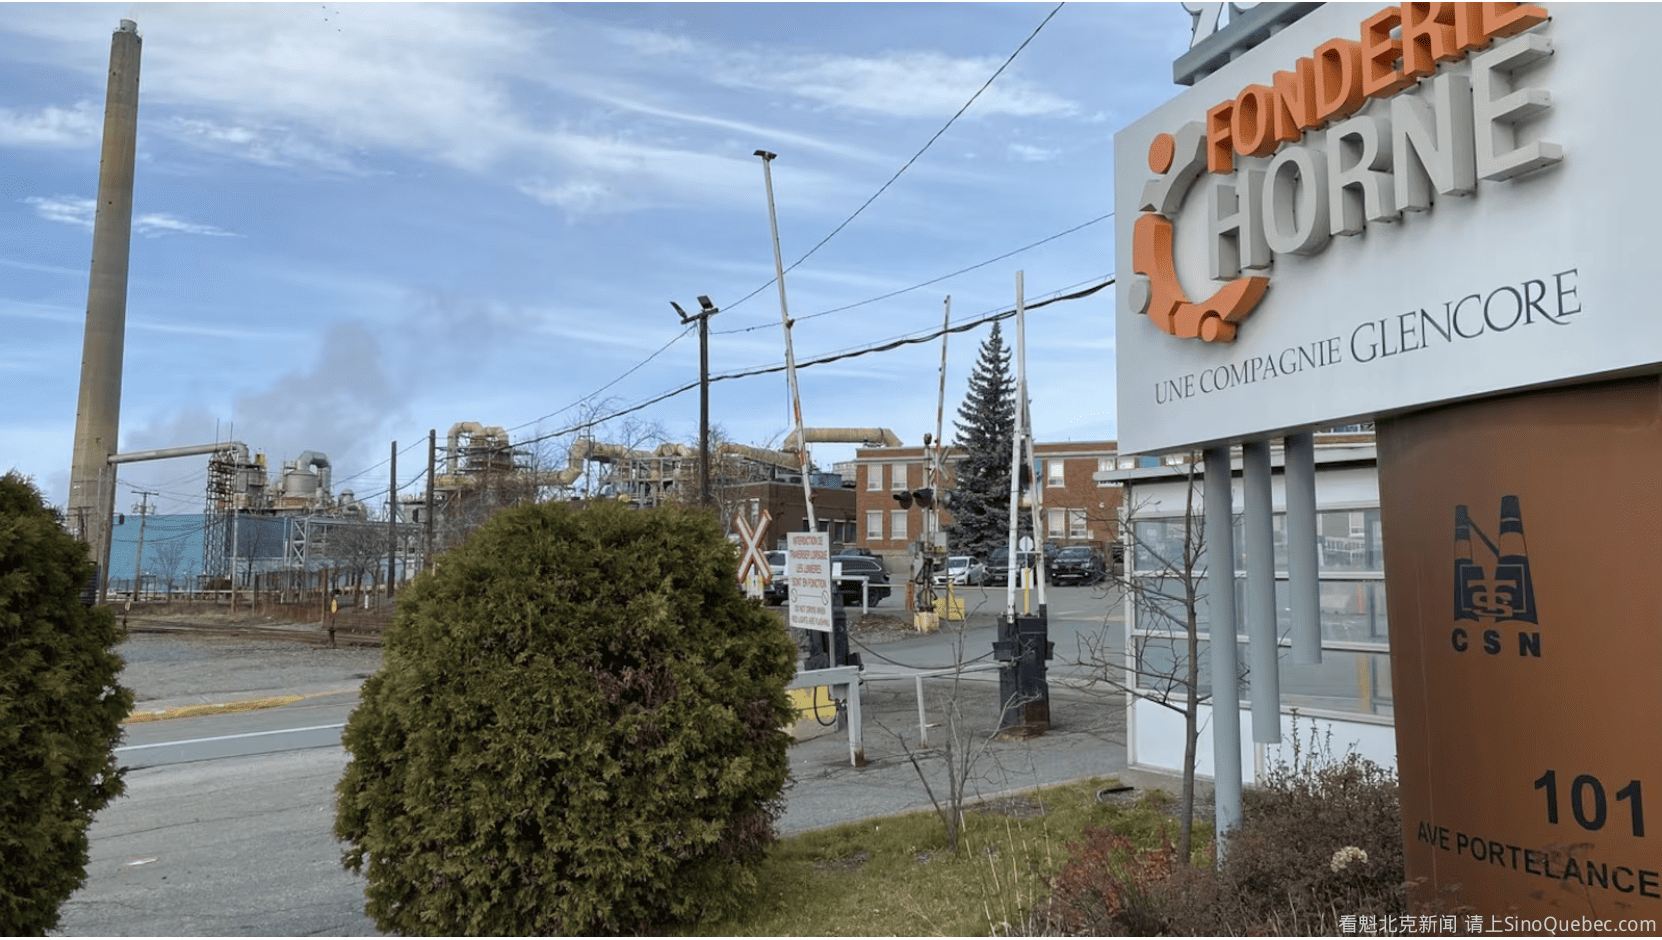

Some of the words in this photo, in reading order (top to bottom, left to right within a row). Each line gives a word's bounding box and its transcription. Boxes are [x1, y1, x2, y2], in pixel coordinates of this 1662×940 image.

[1208, 32, 1563, 280] HORNE
[1154, 374, 1195, 405] UNE
[1199, 336, 1342, 394] COMPAGNIE
[1350, 268, 1582, 364] GLENCORE
[1535, 769, 1645, 838] 101
[1418, 821, 1450, 851] AVE
[1457, 832, 1662, 898] PORTELANCE
